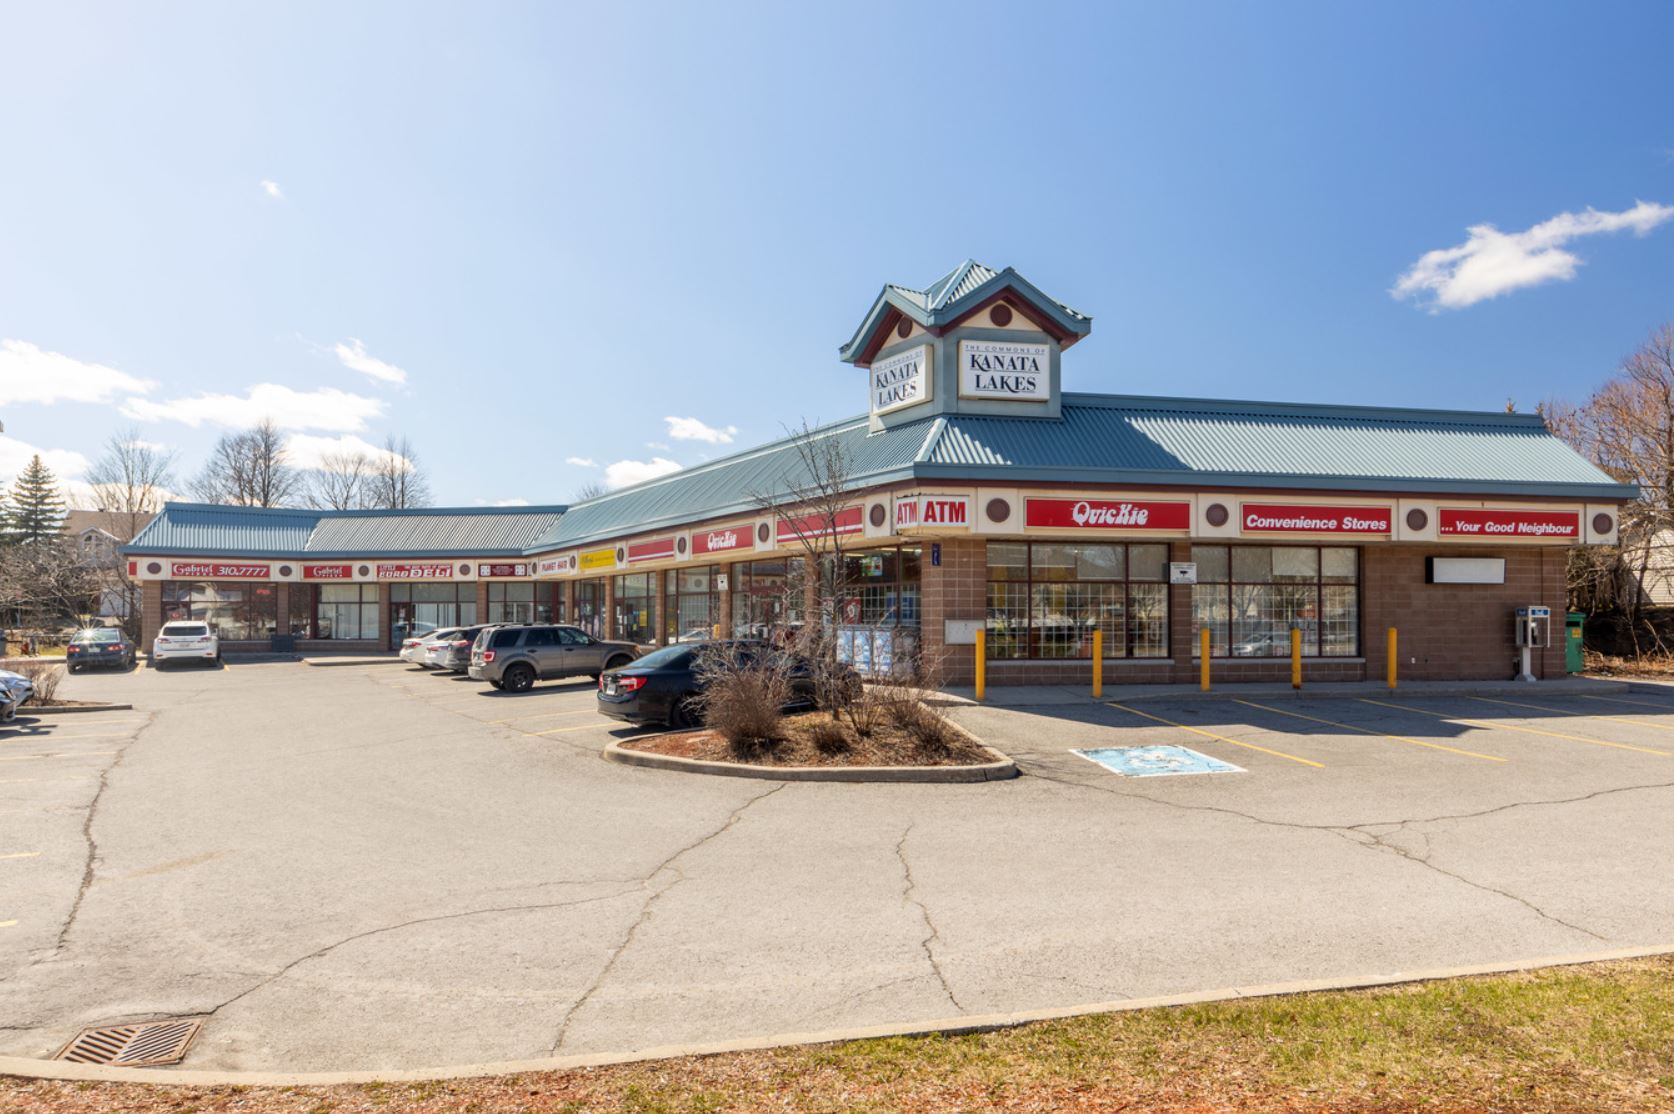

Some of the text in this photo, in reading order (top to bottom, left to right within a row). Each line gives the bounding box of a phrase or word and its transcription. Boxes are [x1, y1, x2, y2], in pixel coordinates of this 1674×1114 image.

[965, 344, 982, 352] THE
[985, 345, 1031, 353] COMMONS
[970, 354, 1041, 372] KANATA
[876, 361, 919, 388] KANATA
[975, 374, 1037, 393] LAKES
[878, 381, 917, 405] LAKES
[897, 498, 918, 522] ATM
[923, 501, 966, 523] ATM
[1246, 515, 1387, 531] Convenience Stores
[1455, 521, 1481, 533] Your
[1484, 521, 1515, 534] Good
[1517, 522, 1574, 536] Neighbour
[410, 568, 451, 578] DELI
